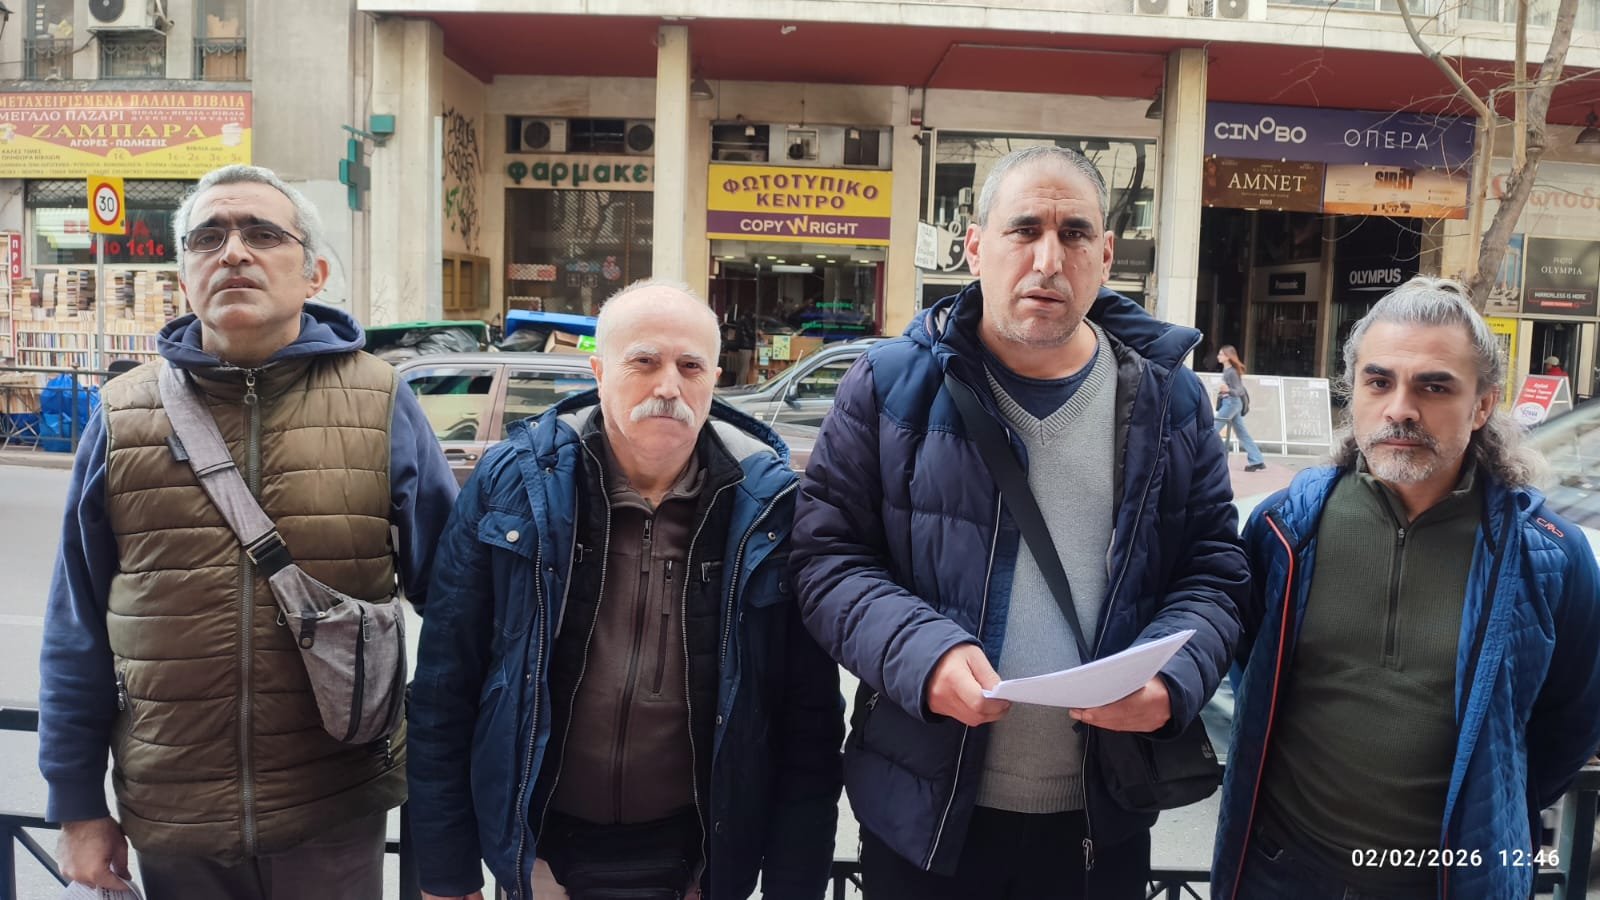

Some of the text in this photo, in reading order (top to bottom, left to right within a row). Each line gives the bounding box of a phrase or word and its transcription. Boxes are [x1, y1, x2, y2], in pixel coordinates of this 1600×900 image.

[193, 95, 245, 107] ΒΙΒΛΙΑ
[0, 110, 124, 121] ΜΕΓΑΛΟ ΠΑΖΑΡΙ
[31, 123, 207, 139] ΖΑΜΠΑΡΑ
[1214, 117, 1307, 143] CINOBO
[70, 139, 108, 147] ΑΓΟΡΕΣ
[1344, 129, 1429, 150] ΟΠΕΡΑ
[723, 174, 879, 200] ΦΩΤΟΤΥΠΙΚΟ
[99, 196, 114, 212] 30
[756, 193, 846, 209] ΚΕΝΤΡΟ
[1350, 268, 1402, 285] OLYMPUS
[1541, 265, 1583, 275] OLYMPIA
